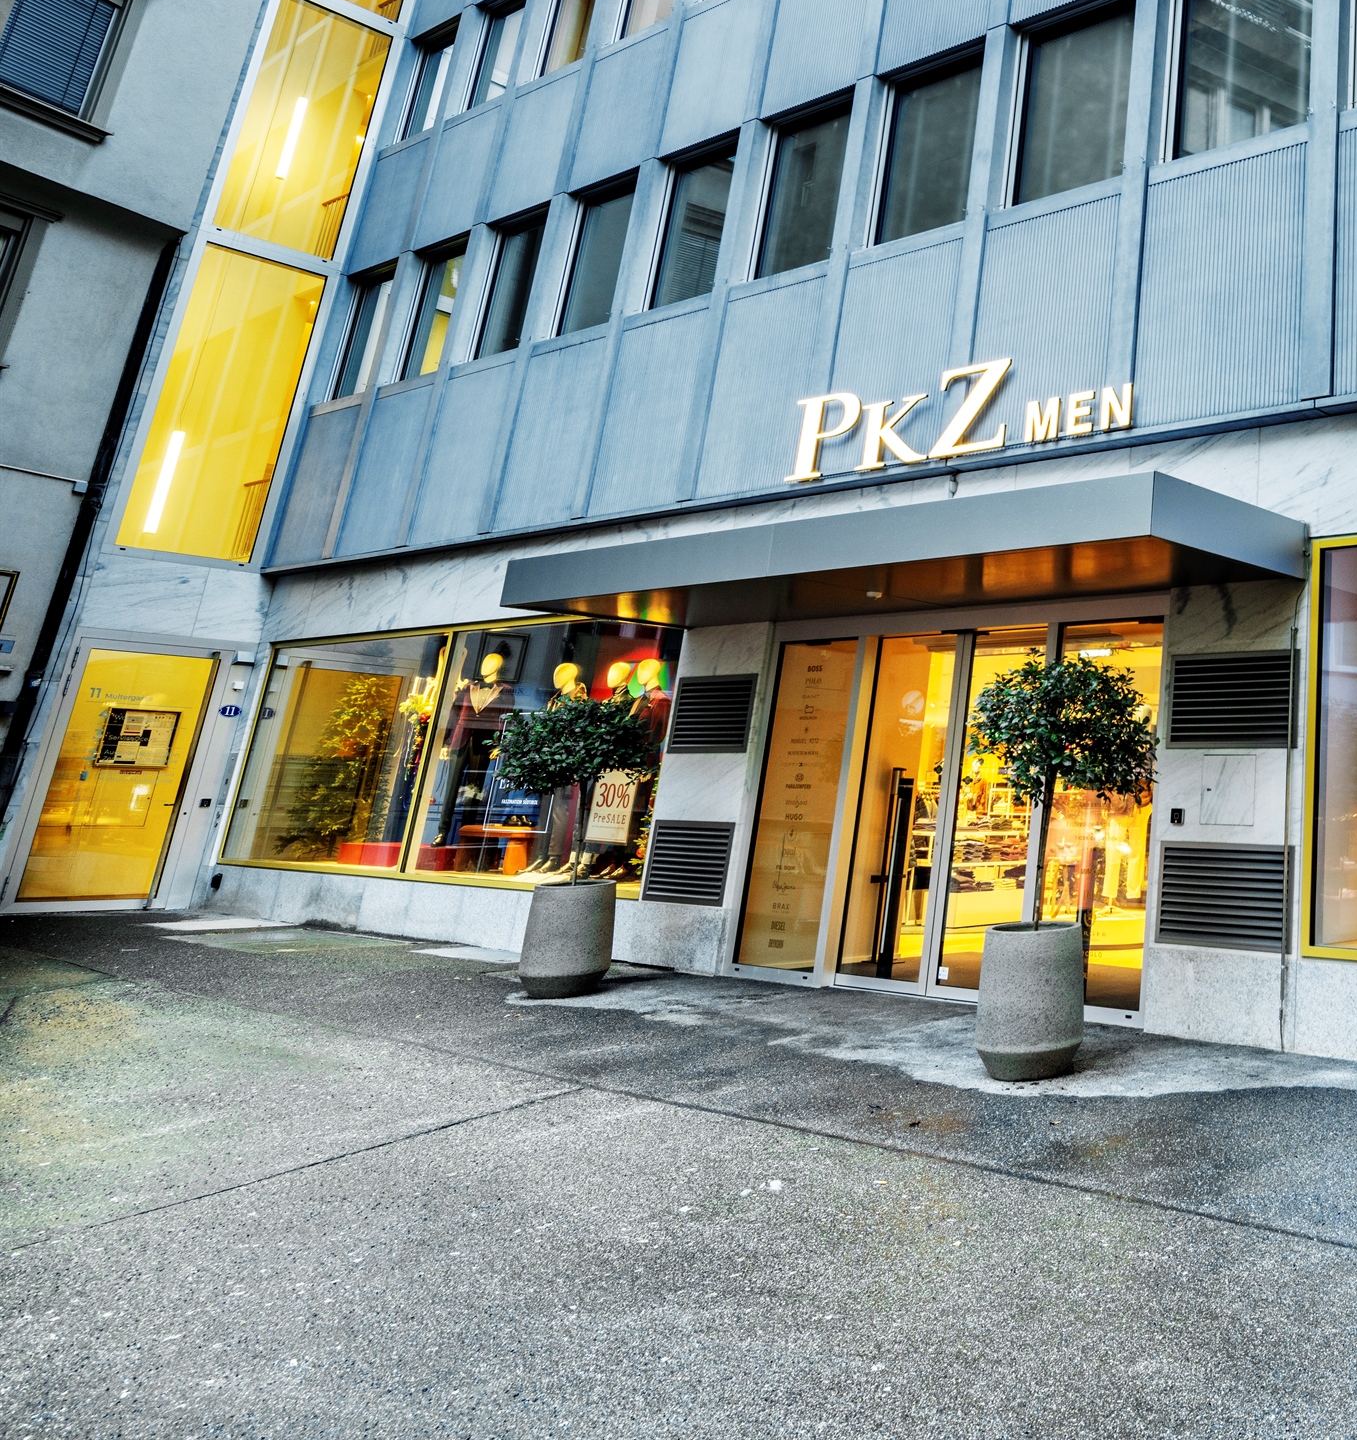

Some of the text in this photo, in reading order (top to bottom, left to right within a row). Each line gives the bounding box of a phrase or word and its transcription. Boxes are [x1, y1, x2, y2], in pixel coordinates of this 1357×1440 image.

[784, 358, 1134, 483] PKZ MEN
[807, 665, 823, 673] BOSS
[89, 687, 154, 703] 11 Multergasse
[224, 706, 236, 716] 11
[595, 782, 631, 809] 30%
[592, 812, 627, 825] PreSALE
[785, 813, 804, 821] HUGO
[772, 902, 790, 911] BRAX
